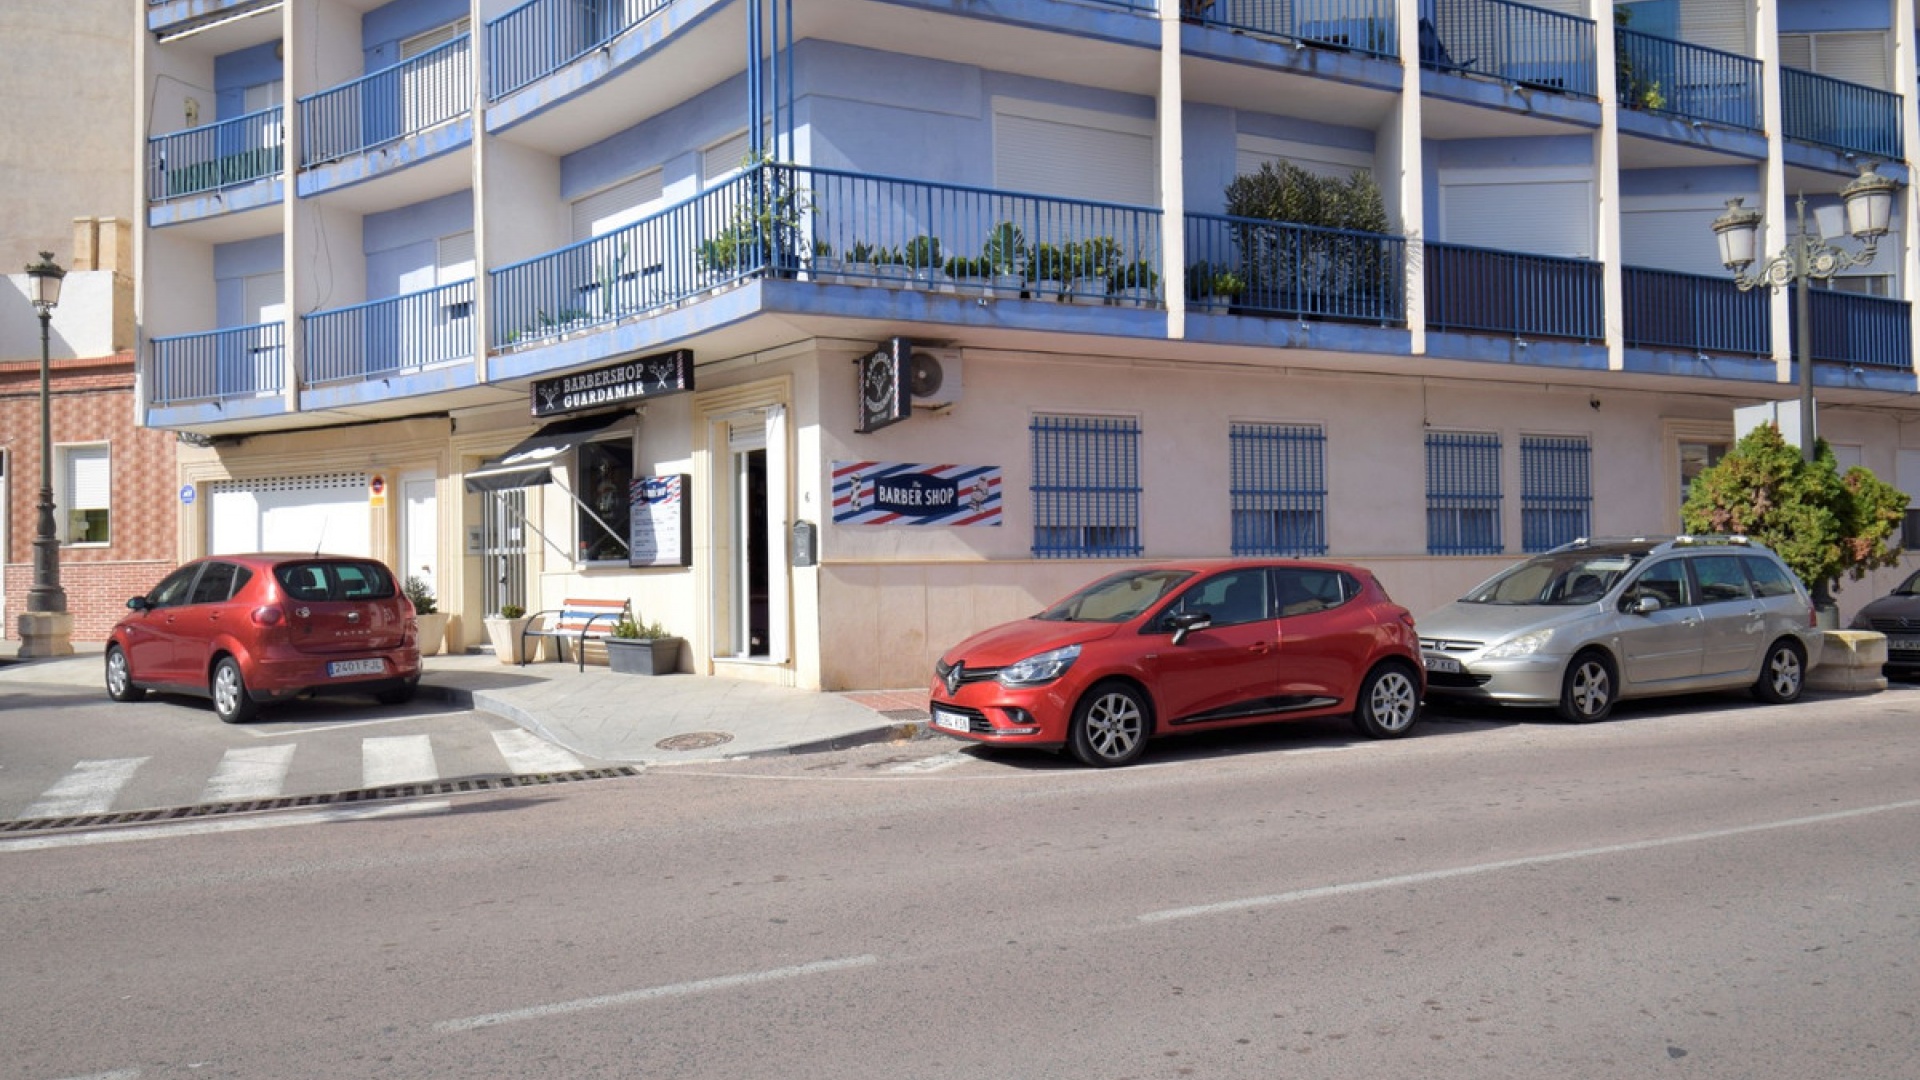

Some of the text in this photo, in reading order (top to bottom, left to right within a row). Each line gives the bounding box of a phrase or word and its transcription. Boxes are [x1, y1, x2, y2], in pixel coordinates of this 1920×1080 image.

[563, 363, 644, 393] BARBERSHOP
[564, 382, 645, 408] GUARDAMAR
[879, 486, 955, 506] BARBER SHOP
